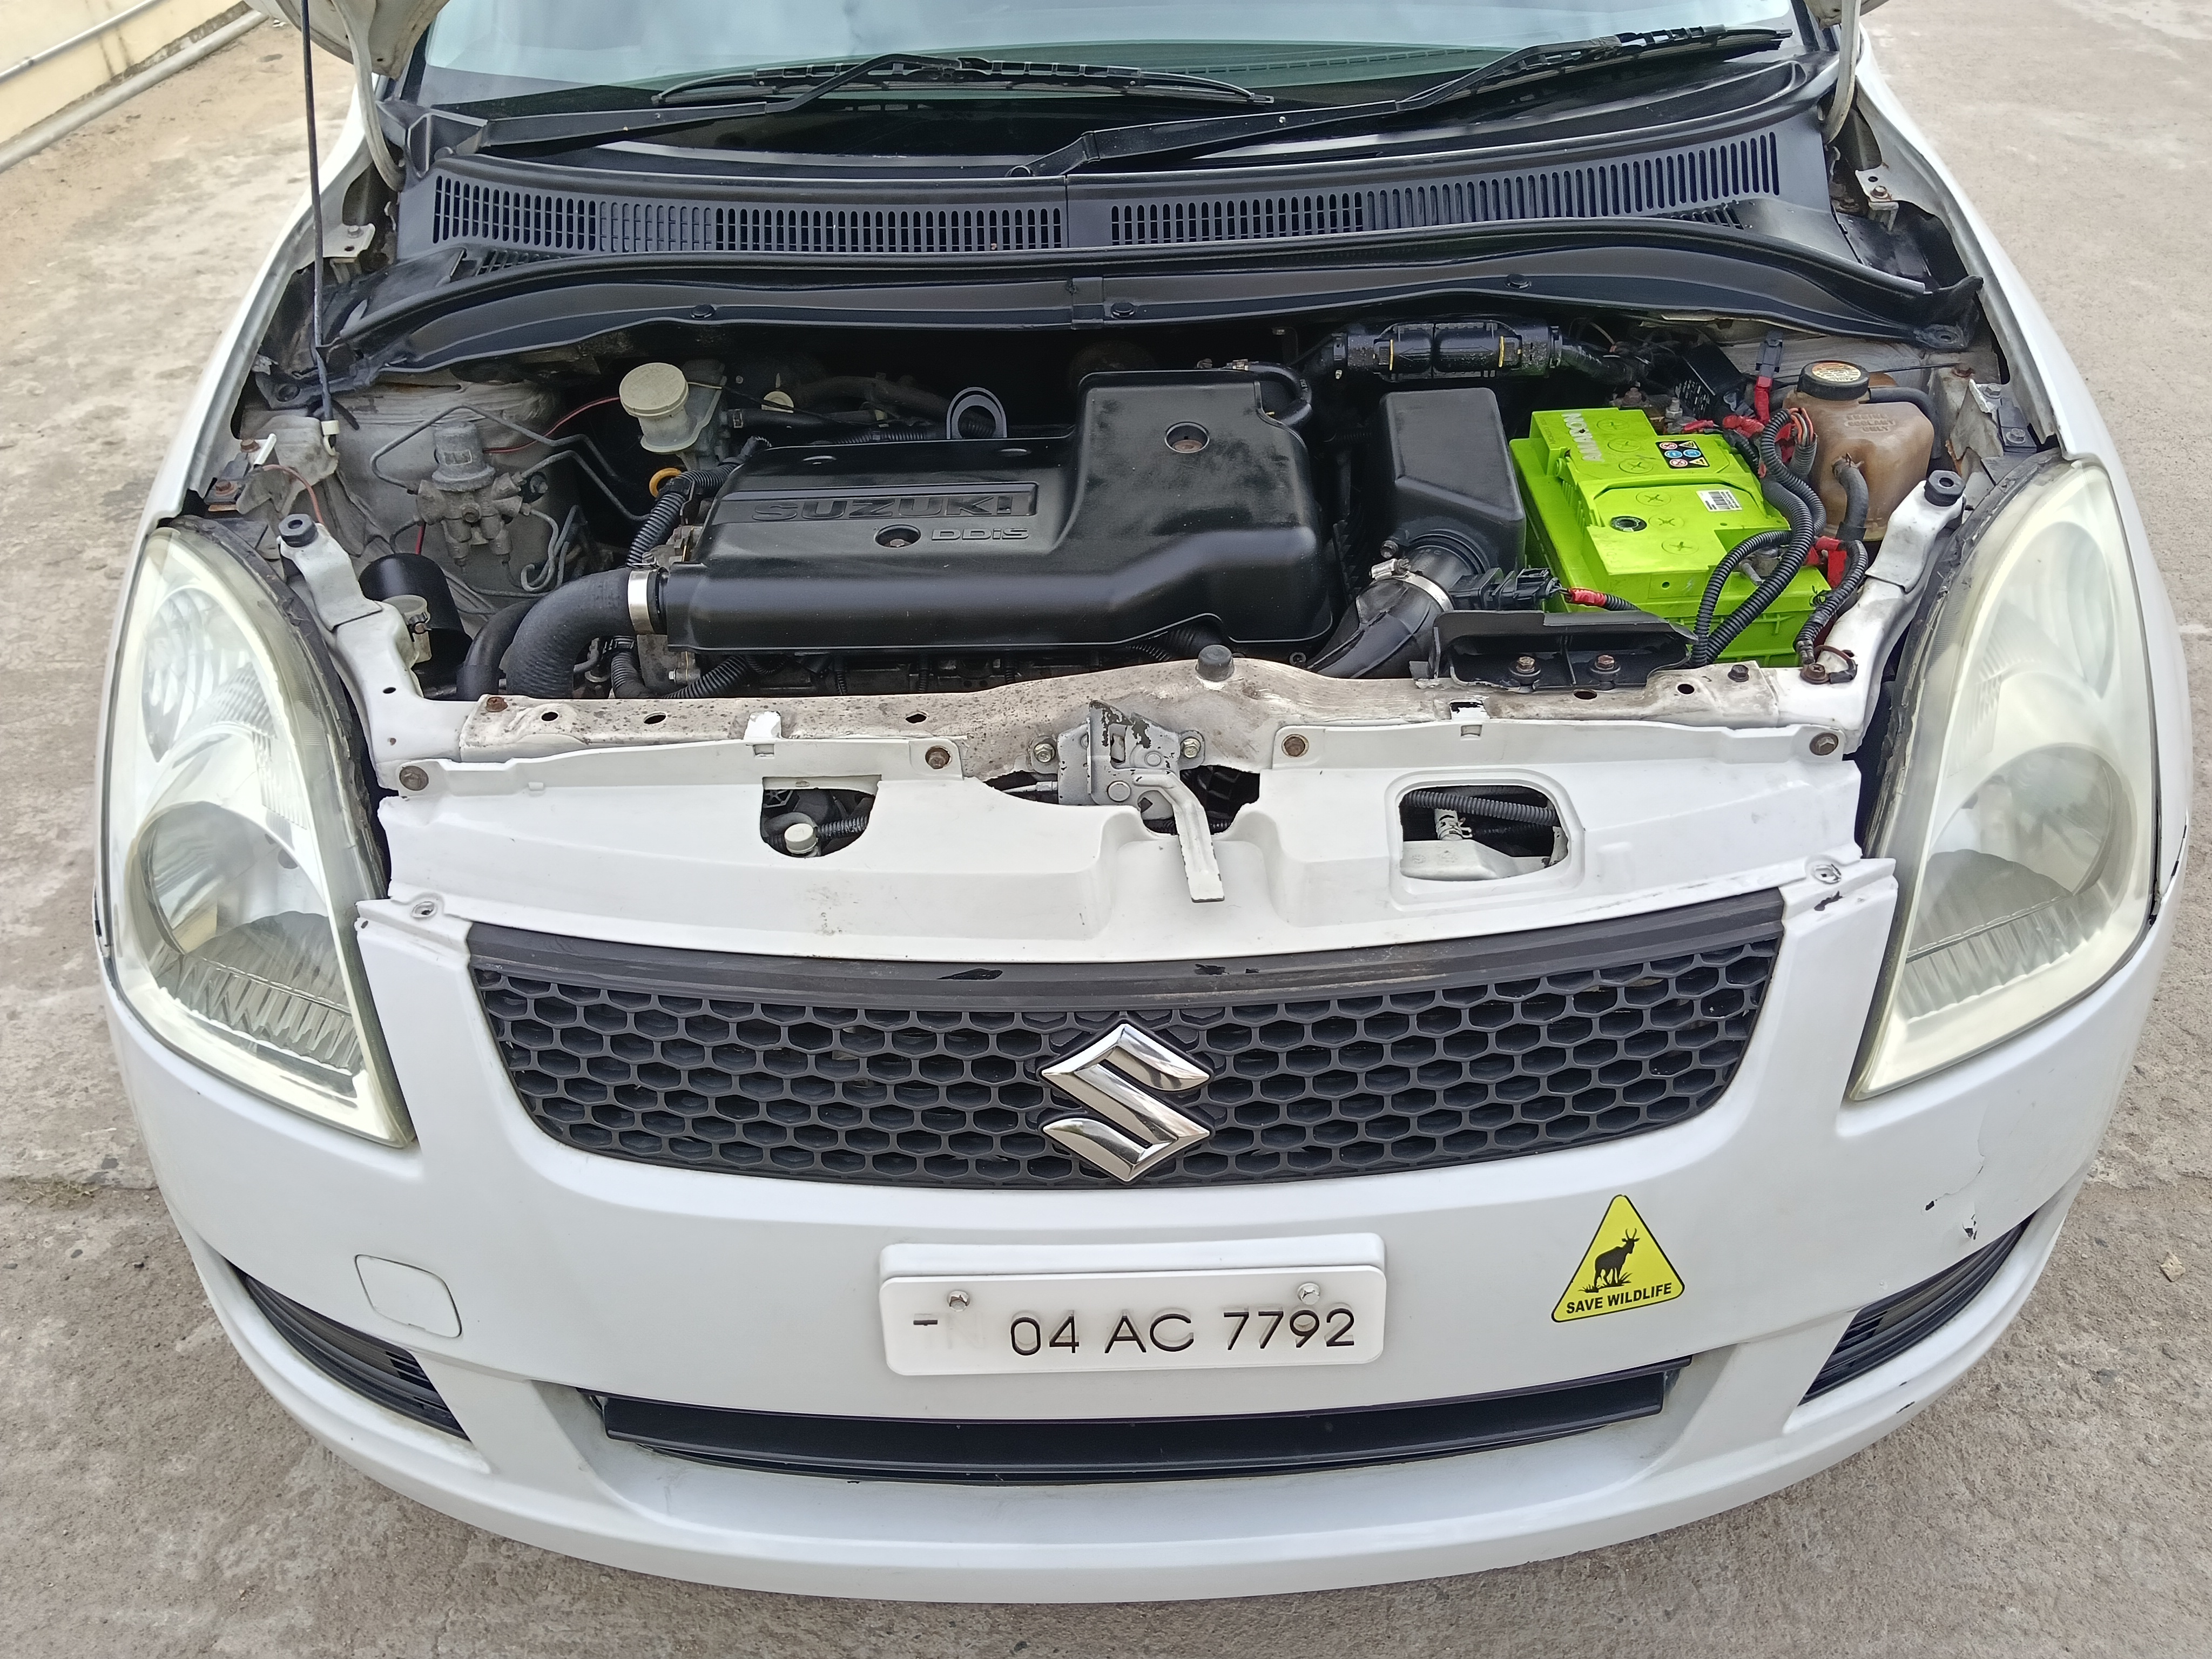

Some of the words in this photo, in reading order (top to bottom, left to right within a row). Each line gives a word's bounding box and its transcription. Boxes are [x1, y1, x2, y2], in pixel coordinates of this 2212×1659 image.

[752, 496, 1013, 521] SUZUKI
[1566, 1297, 1603, 1313] SAVE
[1607, 1283, 1672, 1306] WILDLIFE
[1010, 1310, 1080, 1356] 04
[1104, 1309, 1194, 1353] AC
[1223, 1304, 1355, 1350] 7792
